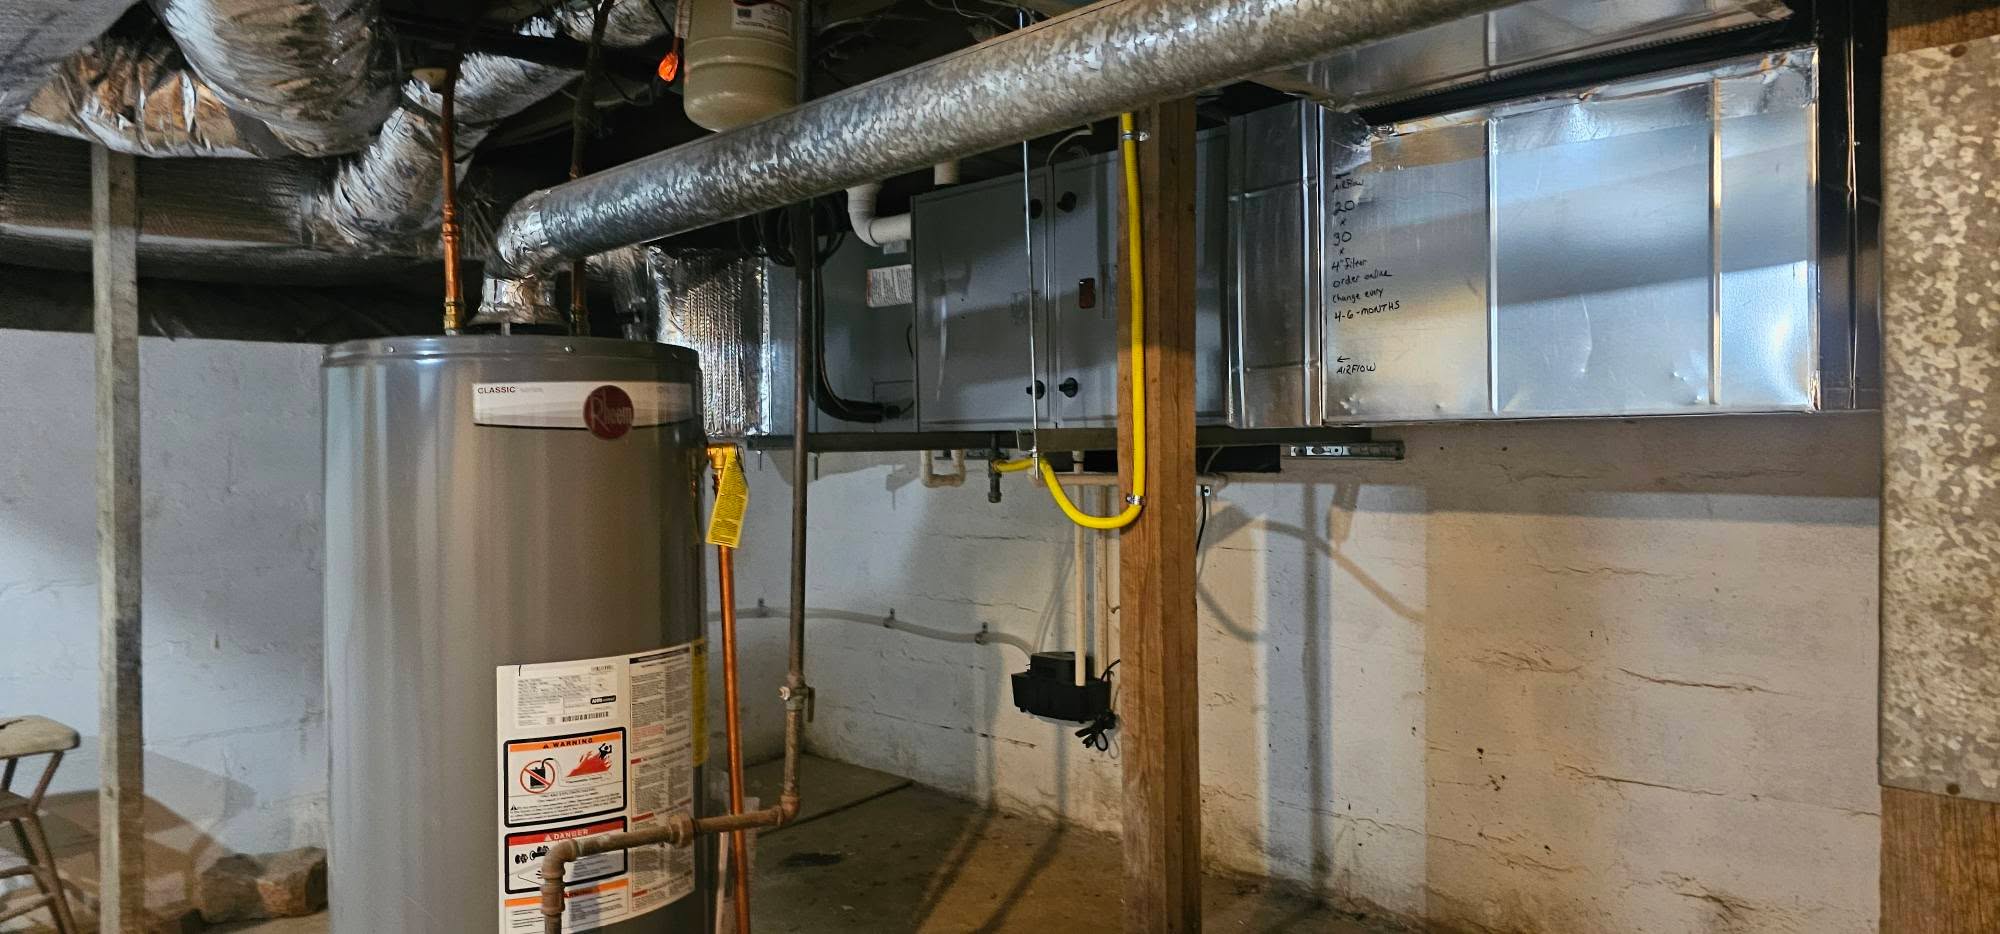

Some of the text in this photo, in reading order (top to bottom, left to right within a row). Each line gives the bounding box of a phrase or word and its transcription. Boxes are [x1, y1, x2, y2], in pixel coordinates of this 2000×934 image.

[1333, 200, 1355, 216] 20
[1333, 231, 1352, 246] 30
[1333, 275, 1360, 288] order
[477, 386, 516, 394] CLASSIC
[589, 389, 633, 432] Rheem
[552, 737, 594, 748] WARNING
[553, 829, 589, 840] DANGER
